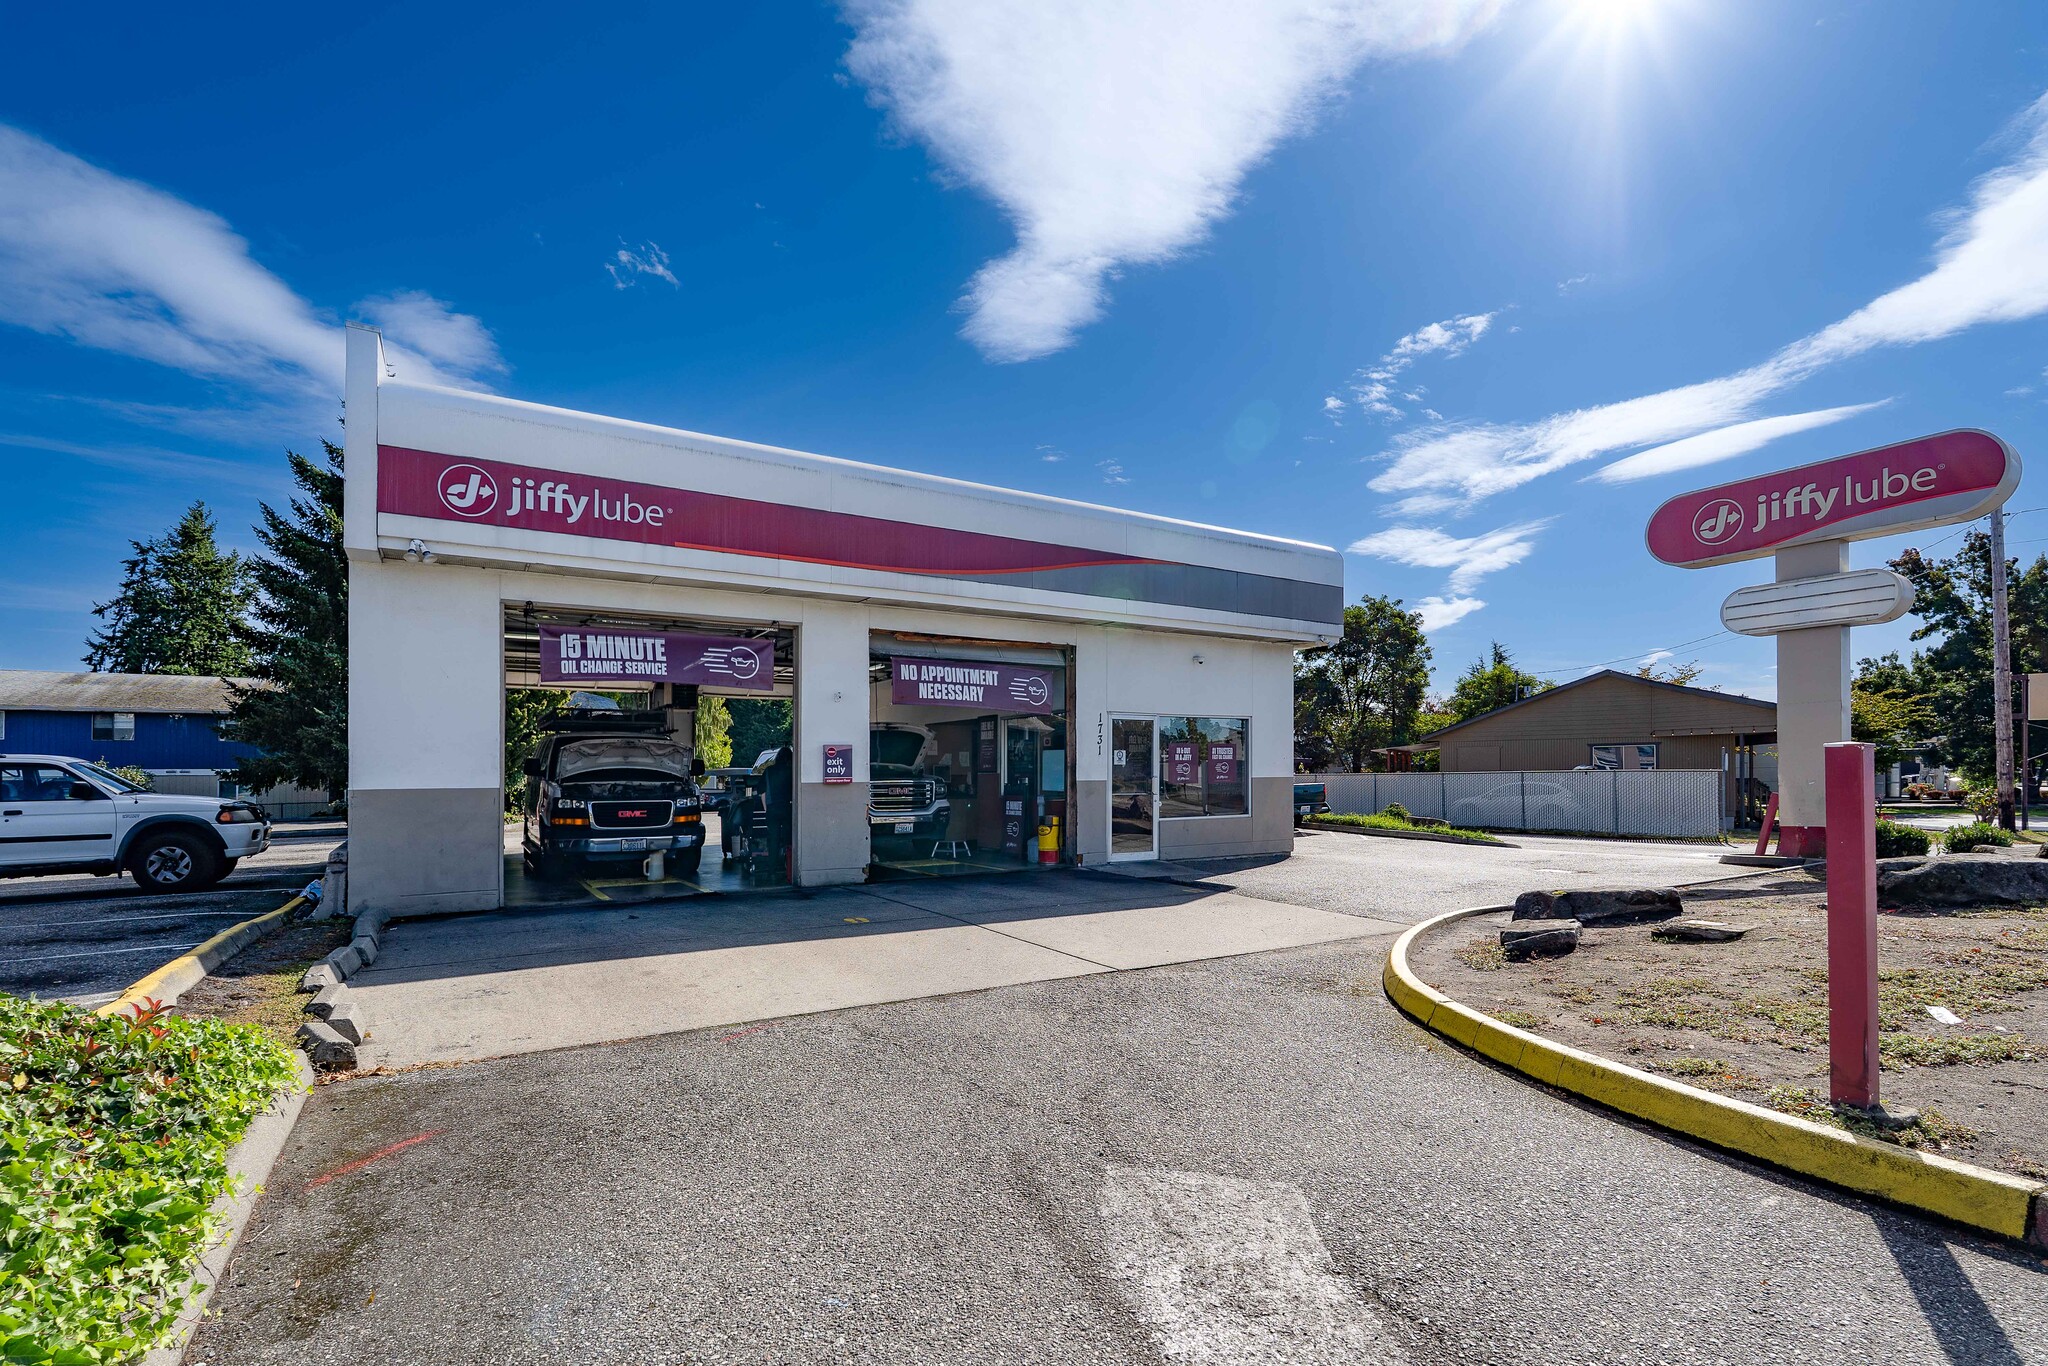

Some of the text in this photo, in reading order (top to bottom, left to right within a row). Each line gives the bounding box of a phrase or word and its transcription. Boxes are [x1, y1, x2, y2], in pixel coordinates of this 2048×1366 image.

[506, 477, 664, 527] jiffy lube
[1752, 466, 1937, 533] jiffy lube
[560, 633, 667, 661] 15 MINUTE
[561, 660, 668, 676] OIL CHANGE SERVICE
[900, 664, 999, 686] NO APPOINTMENT
[918, 682, 985, 702] NECESSARY
[826, 757, 843, 766] exit
[826, 765, 846, 775] only
[888, 787, 914, 795] GMC
